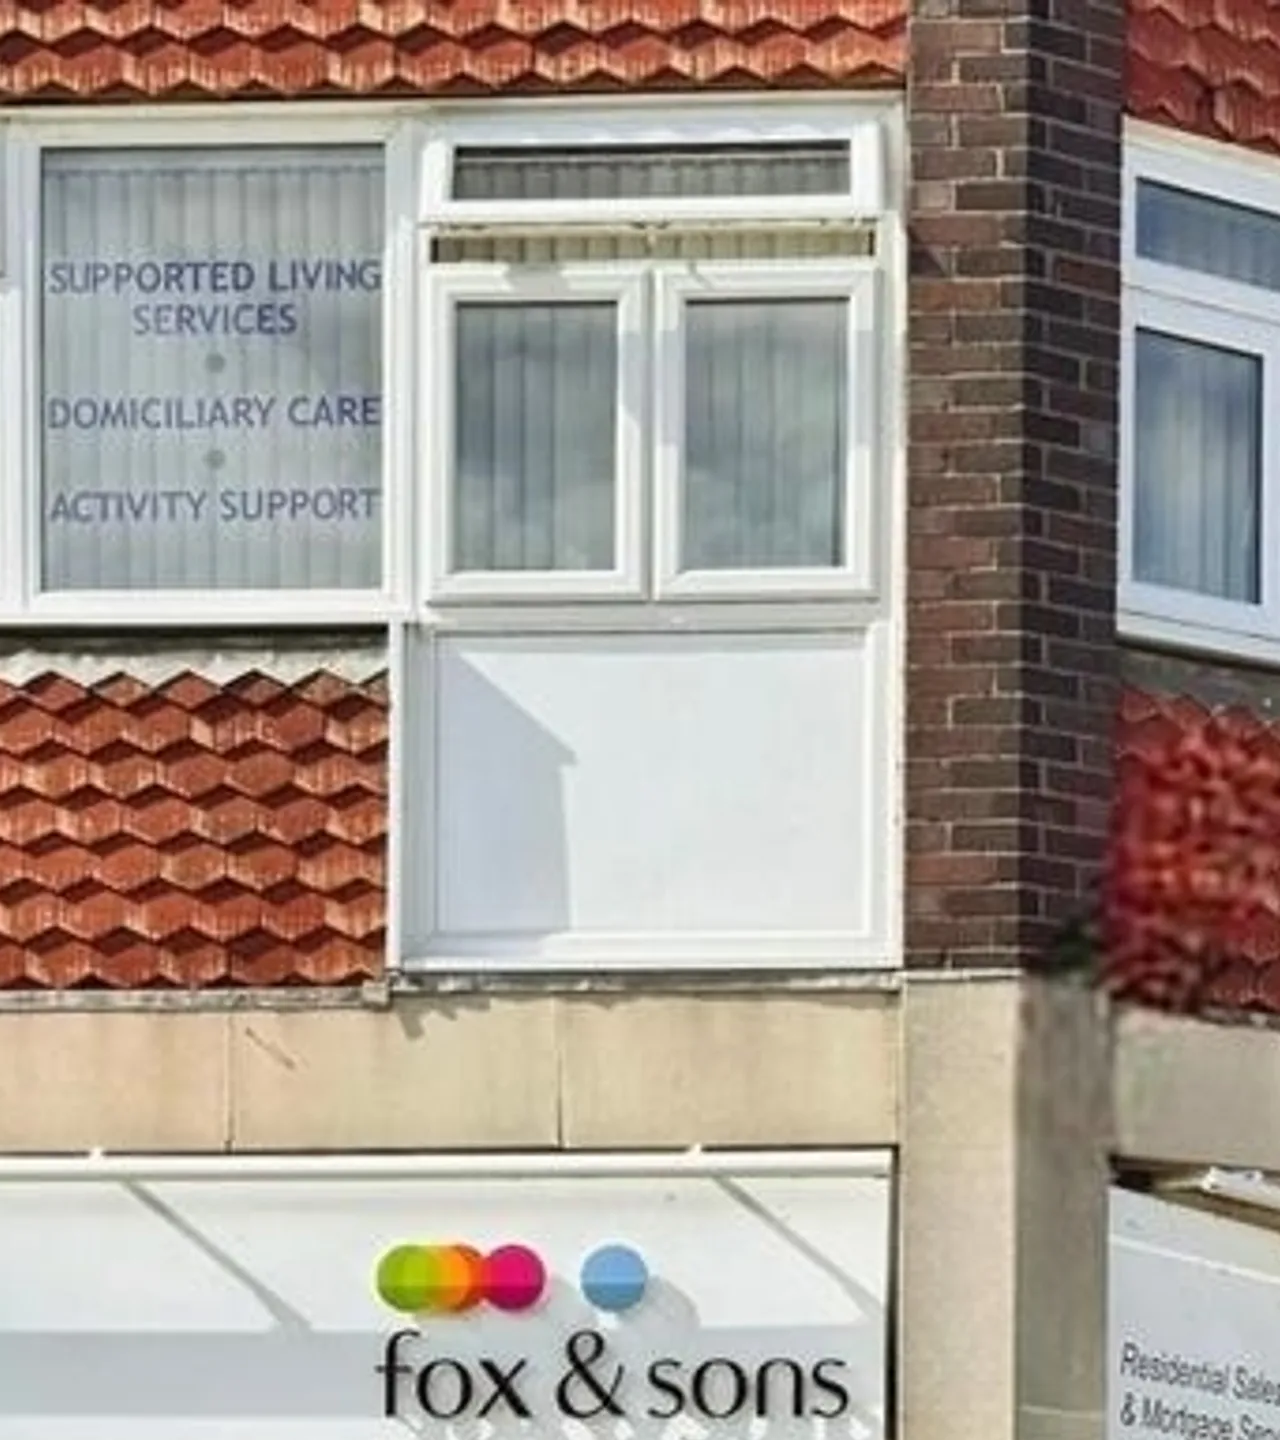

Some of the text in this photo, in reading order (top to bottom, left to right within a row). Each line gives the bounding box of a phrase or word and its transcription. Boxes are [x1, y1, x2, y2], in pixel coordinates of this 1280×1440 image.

[49, 259, 382, 294] SUPPORTED LIVING
[133, 303, 298, 336] SERVICES
[48, 395, 382, 429] DOMICILIARY CARE
[49, 487, 382, 523] ACTIVITY SUPPORT
[375, 1329, 851, 1419] fox & sons
[1120, 1342, 1231, 1396] Residential
[1120, 1391, 1136, 1427] &
